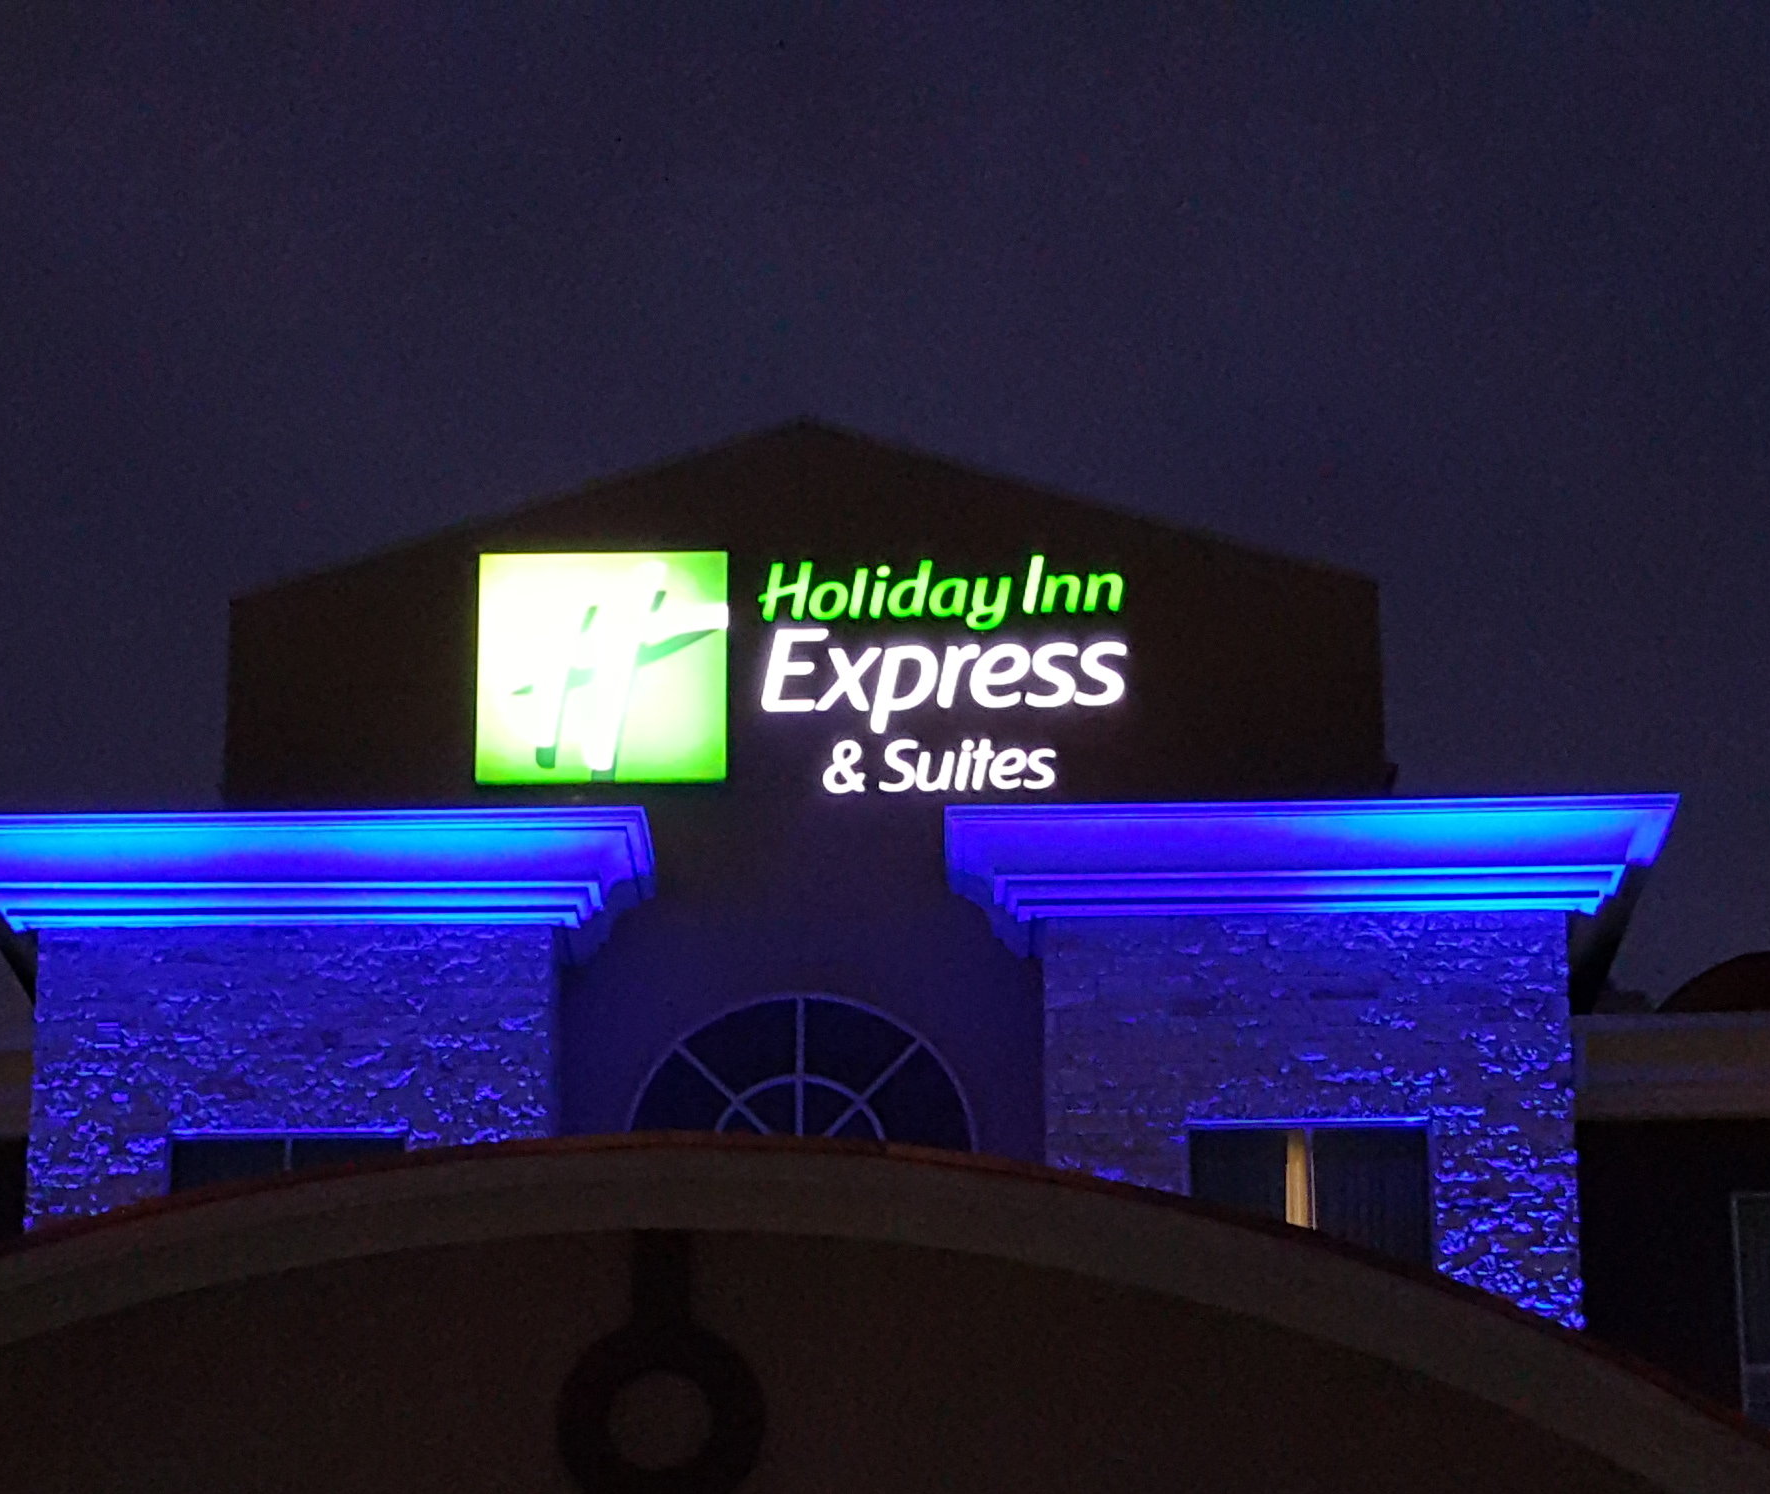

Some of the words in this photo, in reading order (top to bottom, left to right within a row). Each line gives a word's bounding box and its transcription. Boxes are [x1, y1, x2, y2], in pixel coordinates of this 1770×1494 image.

[758, 559, 1009, 632] Holiday
[1022, 554, 1125, 614] Inn
[760, 627, 1128, 734] Express
[822, 741, 865, 794] &
[878, 737, 1057, 793] Suites
